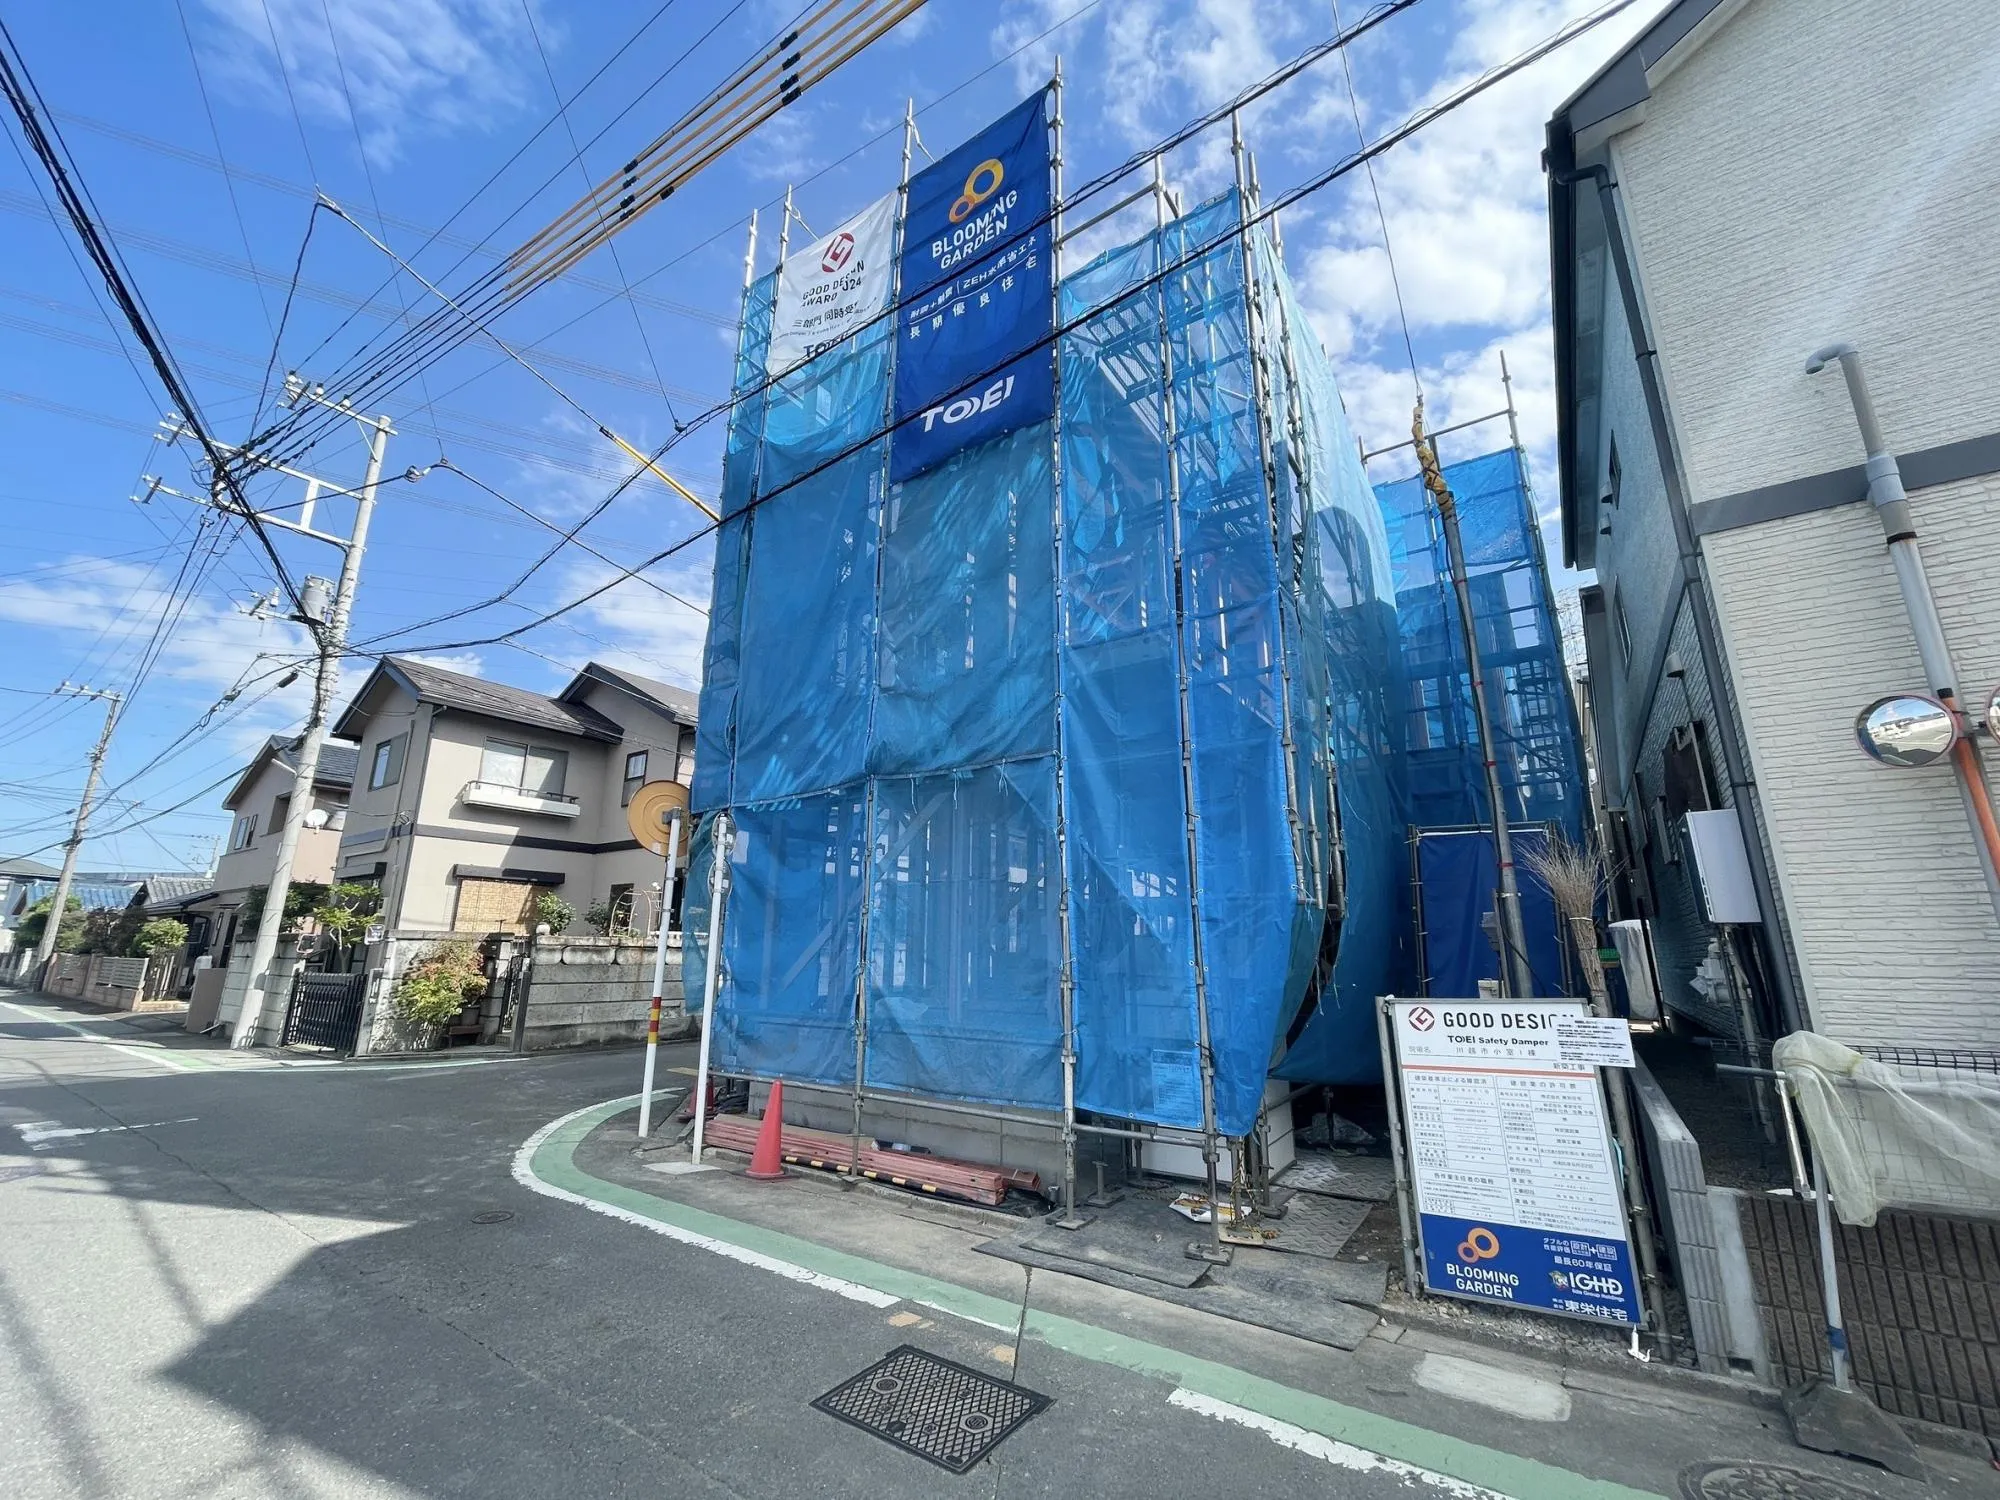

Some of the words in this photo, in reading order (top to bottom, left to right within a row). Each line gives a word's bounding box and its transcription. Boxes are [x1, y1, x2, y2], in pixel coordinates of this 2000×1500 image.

[940, 215, 1008, 269] GARDEN
[802, 284, 830, 301] GOOD
[1443, 1012, 1495, 1028] GOOD
[1478, 1036, 1509, 1046] Safety
[1511, 1038, 1549, 1047] Damper
[1554, 1255, 1613, 1273] 最長60年保証
[1446, 1263, 1520, 1286] BLOOMING
[1455, 1278, 1513, 1299] GARDEN
[1564, 1299, 1629, 1322] 東栄住宅
